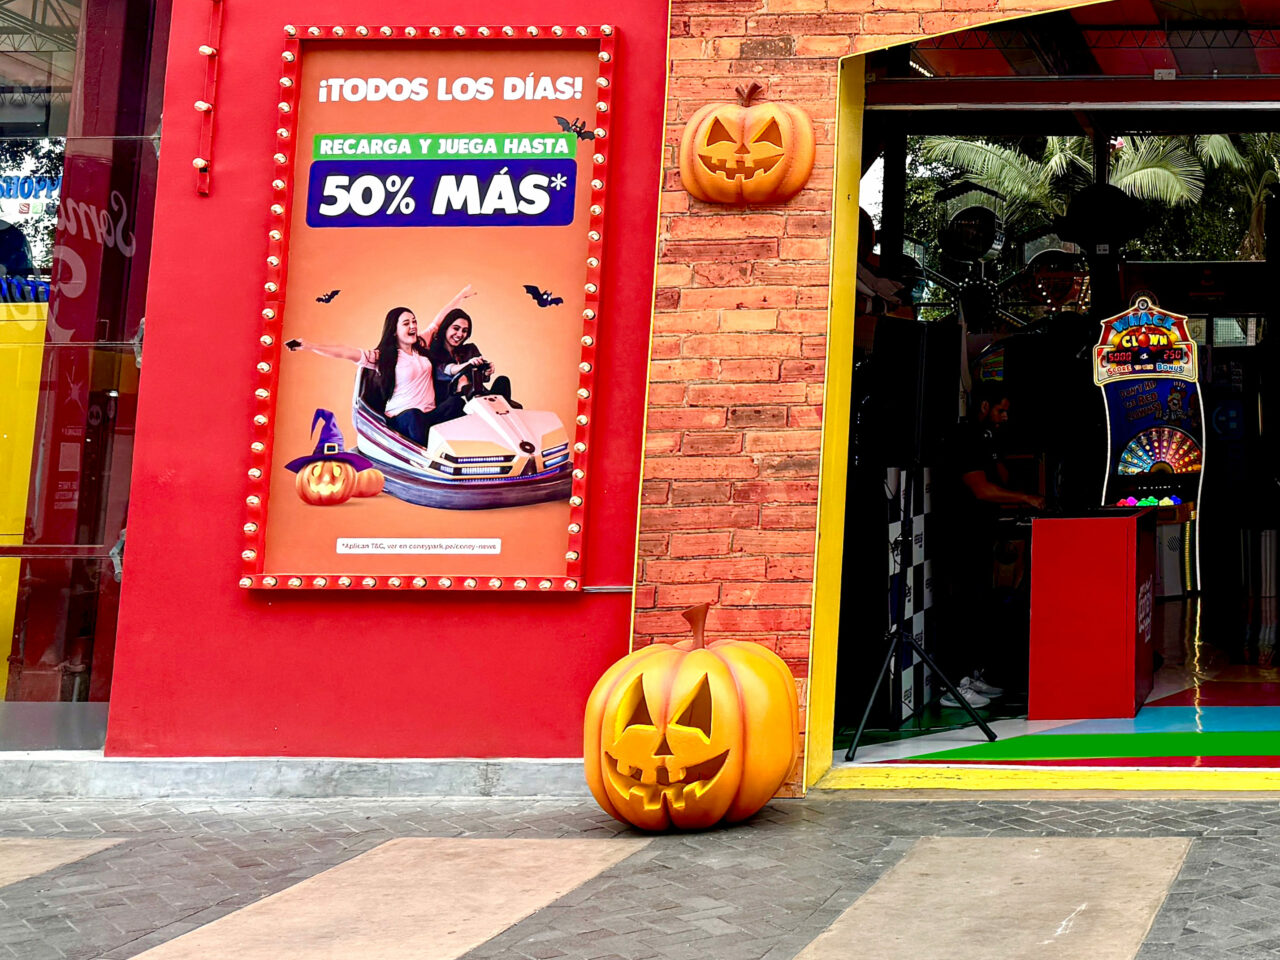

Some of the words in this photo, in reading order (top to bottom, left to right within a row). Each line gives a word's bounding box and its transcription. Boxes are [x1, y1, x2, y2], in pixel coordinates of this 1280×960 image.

[318, 77, 428, 103] ¡TODOS
[437, 76, 494, 101] LOS
[503, 72, 583, 100] DÍAS!
[320, 138, 412, 155] RECARGA
[419, 138, 433, 154] Y
[437, 138, 497, 154] JUEGA
[504, 138, 569, 154] HASTA
[318, 174, 416, 217] 50%
[1111, 311, 1177, 333] WHACK
[1108, 351, 1132, 363] 5000
[1164, 349, 1182, 361] 250
[1107, 365, 1132, 376] SCORE
[1156, 362, 1184, 373] BONUS
